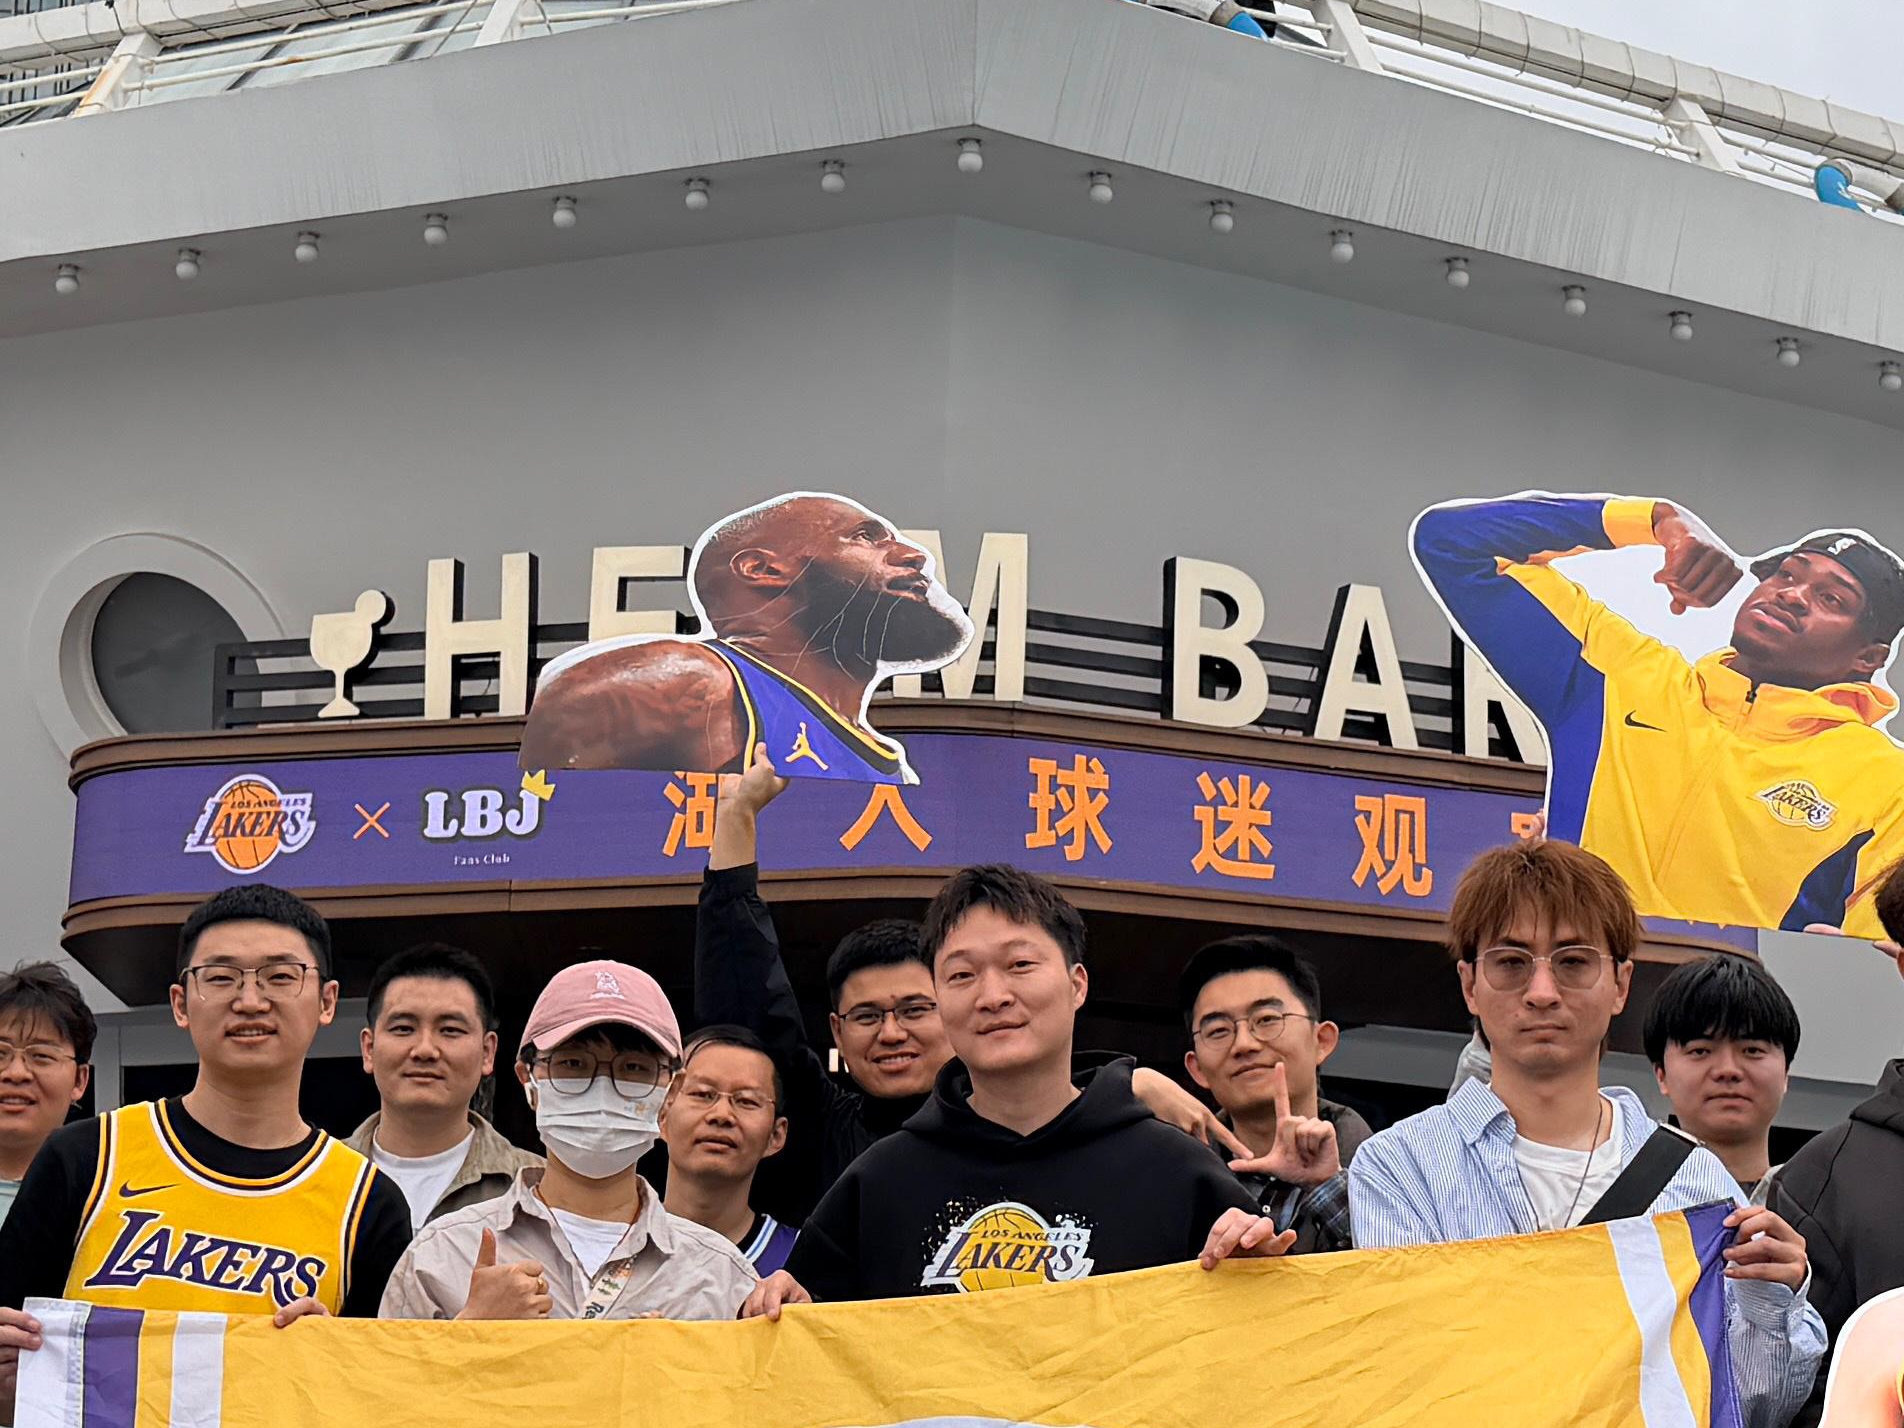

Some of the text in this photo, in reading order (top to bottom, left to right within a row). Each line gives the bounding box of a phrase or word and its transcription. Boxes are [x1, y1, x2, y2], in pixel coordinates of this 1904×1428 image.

[190, 801, 316, 850] LAKERS
[423, 788, 539, 839] LBJ
[454, 854, 510, 866] Fans Club
[82, 1209, 327, 1308] LAKERS
[928, 1230, 1087, 1282] LAKERS
[981, 1228, 1084, 1242] LOS ANGELES
